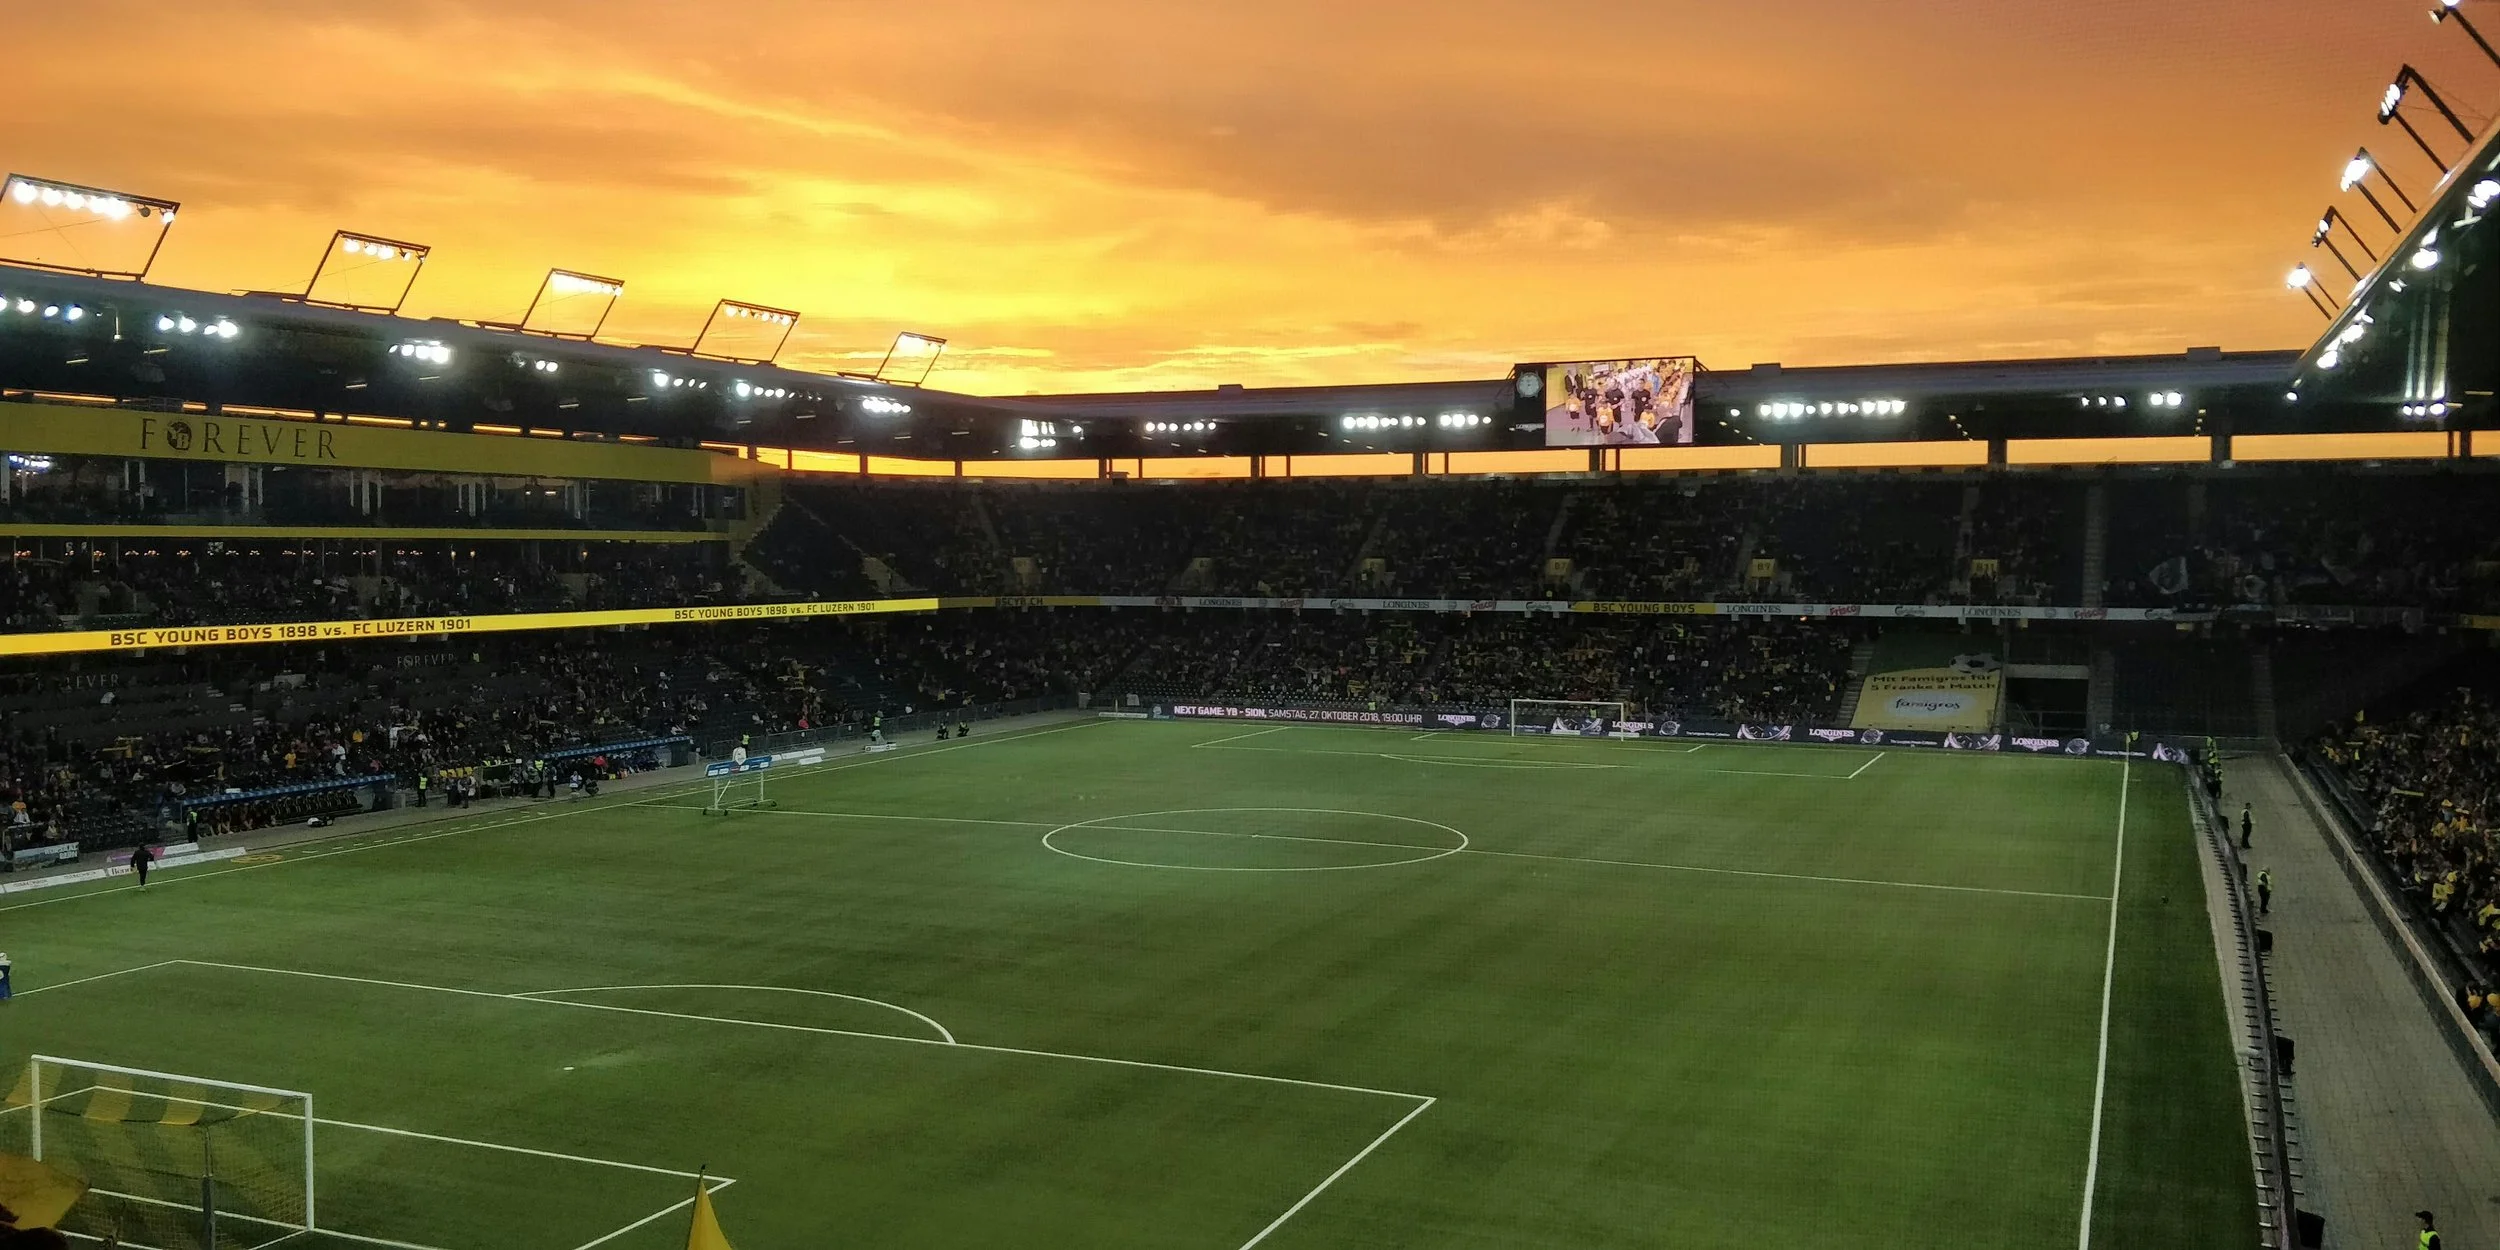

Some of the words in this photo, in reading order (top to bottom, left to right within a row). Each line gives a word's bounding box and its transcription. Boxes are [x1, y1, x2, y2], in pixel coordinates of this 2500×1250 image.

[1200, 599, 1242, 607] LONGINES
[1382, 601, 1430, 609] LONGINES
[1593, 602, 1615, 613] BSC
[1618, 603, 1660, 613] YOUNG
[1663, 604, 1696, 614] BOYS
[674, 609, 695, 620] BSC
[698, 607, 734, 619] YOUNG
[736, 606, 763, 617] BOYS
[766, 605, 788, 616] 1898
[790, 605, 805, 615] vs.
[807, 603, 818, 614] FC
[820, 602, 855, 613] LUZERN
[857, 602, 876, 612] 1901
[1726, 604, 1782, 614] LONGINES
[1961, 607, 2022, 617] LONGINES
[110, 632, 148, 646] BSC
[154, 629, 219, 644] YOUNG
[226, 627, 273, 641] BOYS
[278, 625, 317, 639] 1898
[323, 626, 347, 637] vs.
[353, 622, 371, 635] FC
[376, 620, 435, 634] LUZERN
[440, 618, 472, 631] 1901
[1900, 675, 1966, 684] Famigros
[1884, 683, 1930, 691] Franke
[1949, 682, 1996, 690] Match
[1896, 698, 1961, 712] famigros
[1174, 706, 1197, 716] NEXT
[1198, 706, 1225, 717] GAME:
[1226, 706, 1238, 717] YB
[1245, 707, 1267, 718] SION,
[1269, 709, 1308, 721] SAMSTAG,
[1309, 710, 1320, 720] 27.
[1321, 710, 1358, 721] OKTOBER
[1359, 712, 1380, 723] 2018,
[1382, 713, 1403, 723] 19:00
[1404, 713, 1423, 724] UHR
[1437, 714, 1476, 723] LONGINES
[1808, 728, 1855, 738] LONGINES
[2011, 736, 2060, 748] LONGINES
